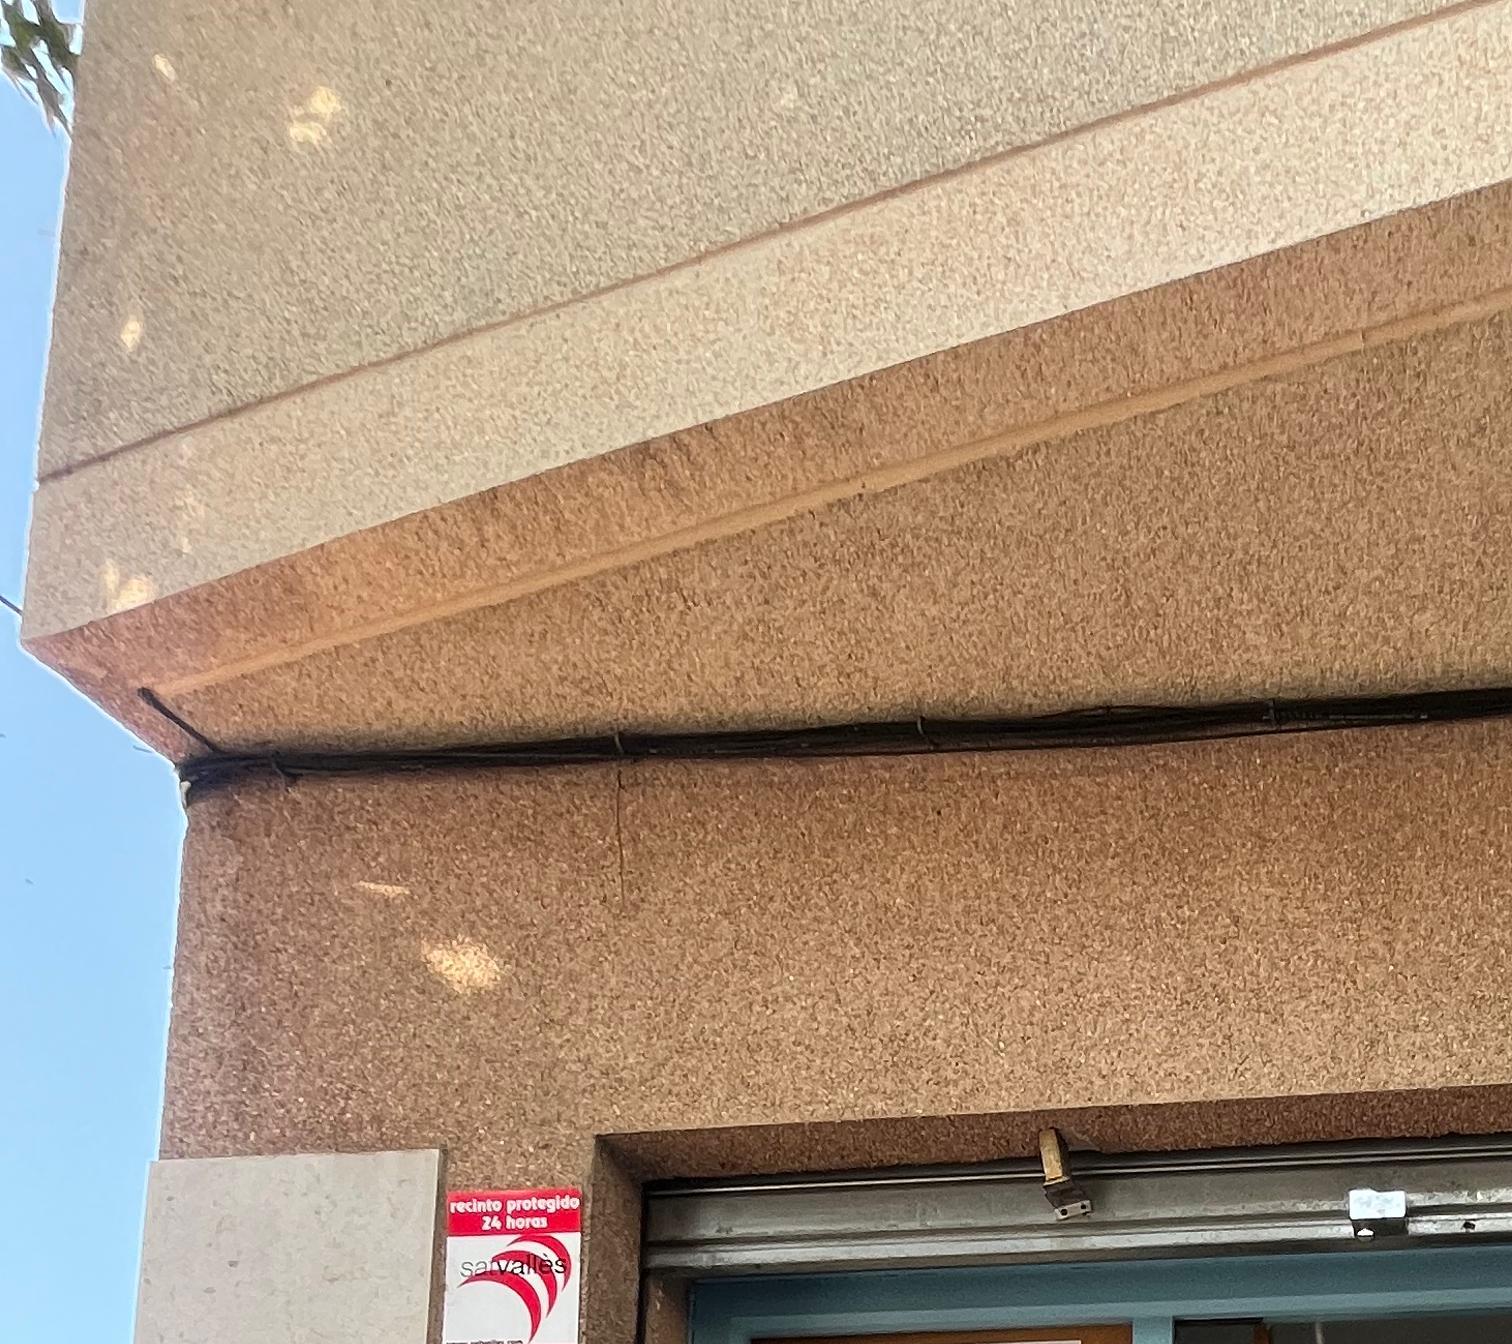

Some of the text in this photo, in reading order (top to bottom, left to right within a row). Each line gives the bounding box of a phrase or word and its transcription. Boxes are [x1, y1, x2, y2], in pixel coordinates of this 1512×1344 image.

[449, 1195, 581, 1215] recinto protegido
[481, 1214, 549, 1231] 24 horas
